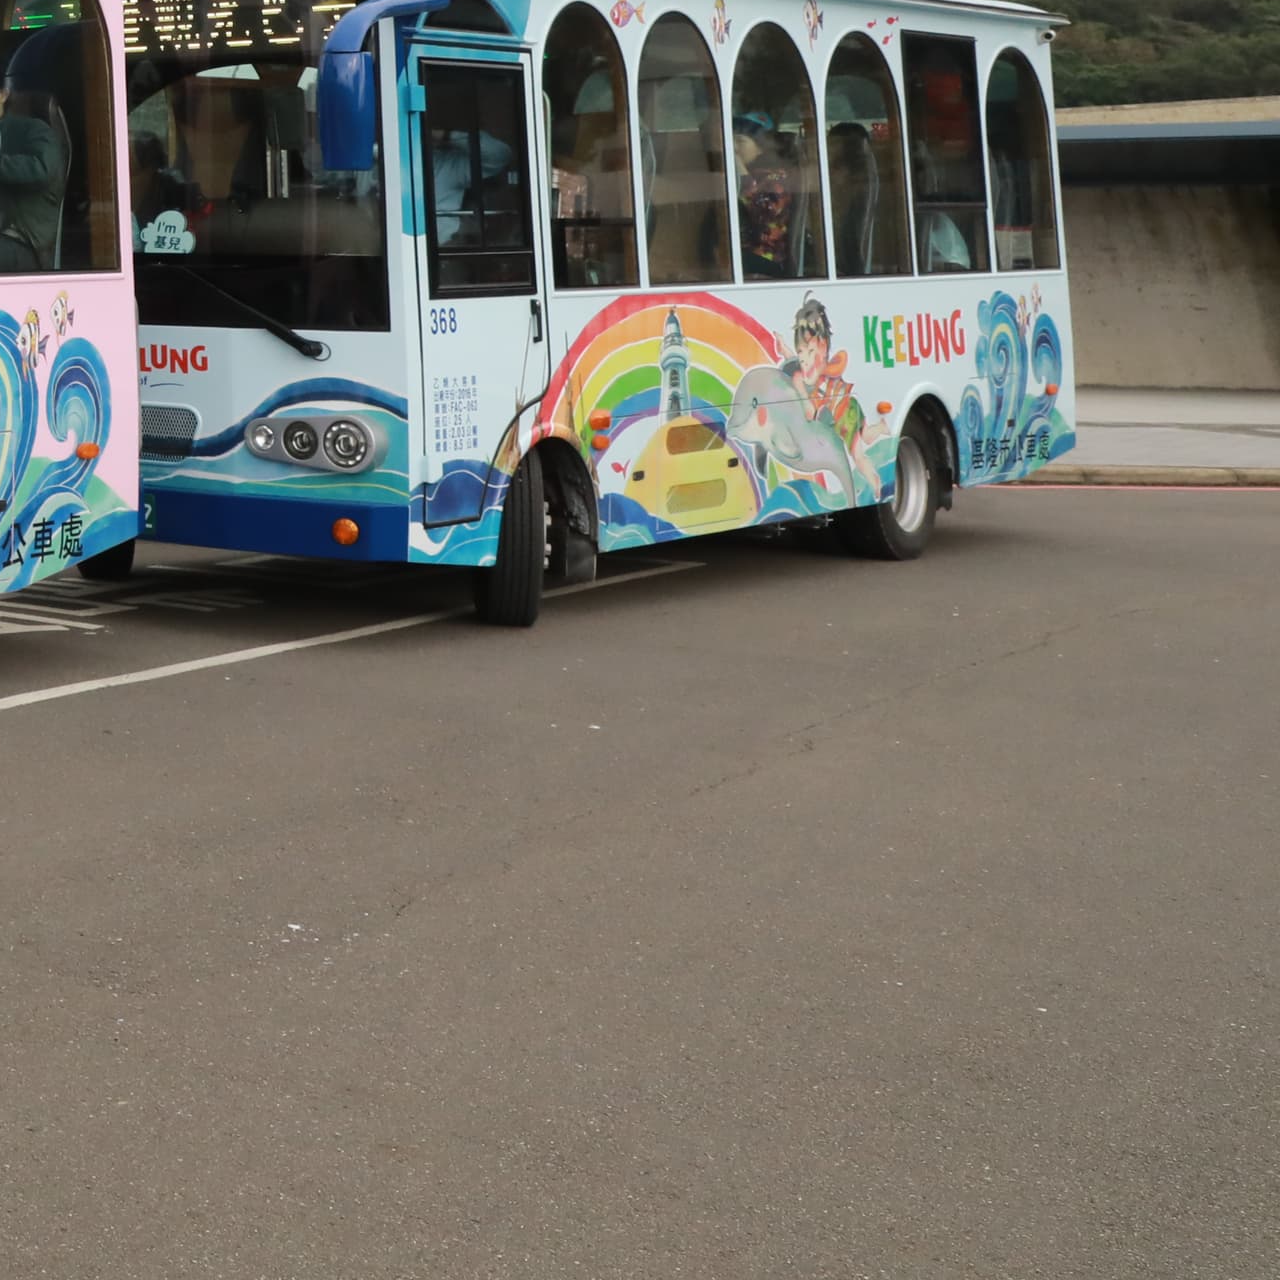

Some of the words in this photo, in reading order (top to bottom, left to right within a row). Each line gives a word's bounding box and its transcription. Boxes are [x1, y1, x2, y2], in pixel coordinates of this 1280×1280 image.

[157, 222, 177, 234] I'm
[430, 308, 457, 334] 368
[863, 309, 965, 368] KEELUNG
[139, 344, 208, 374] LUNG
